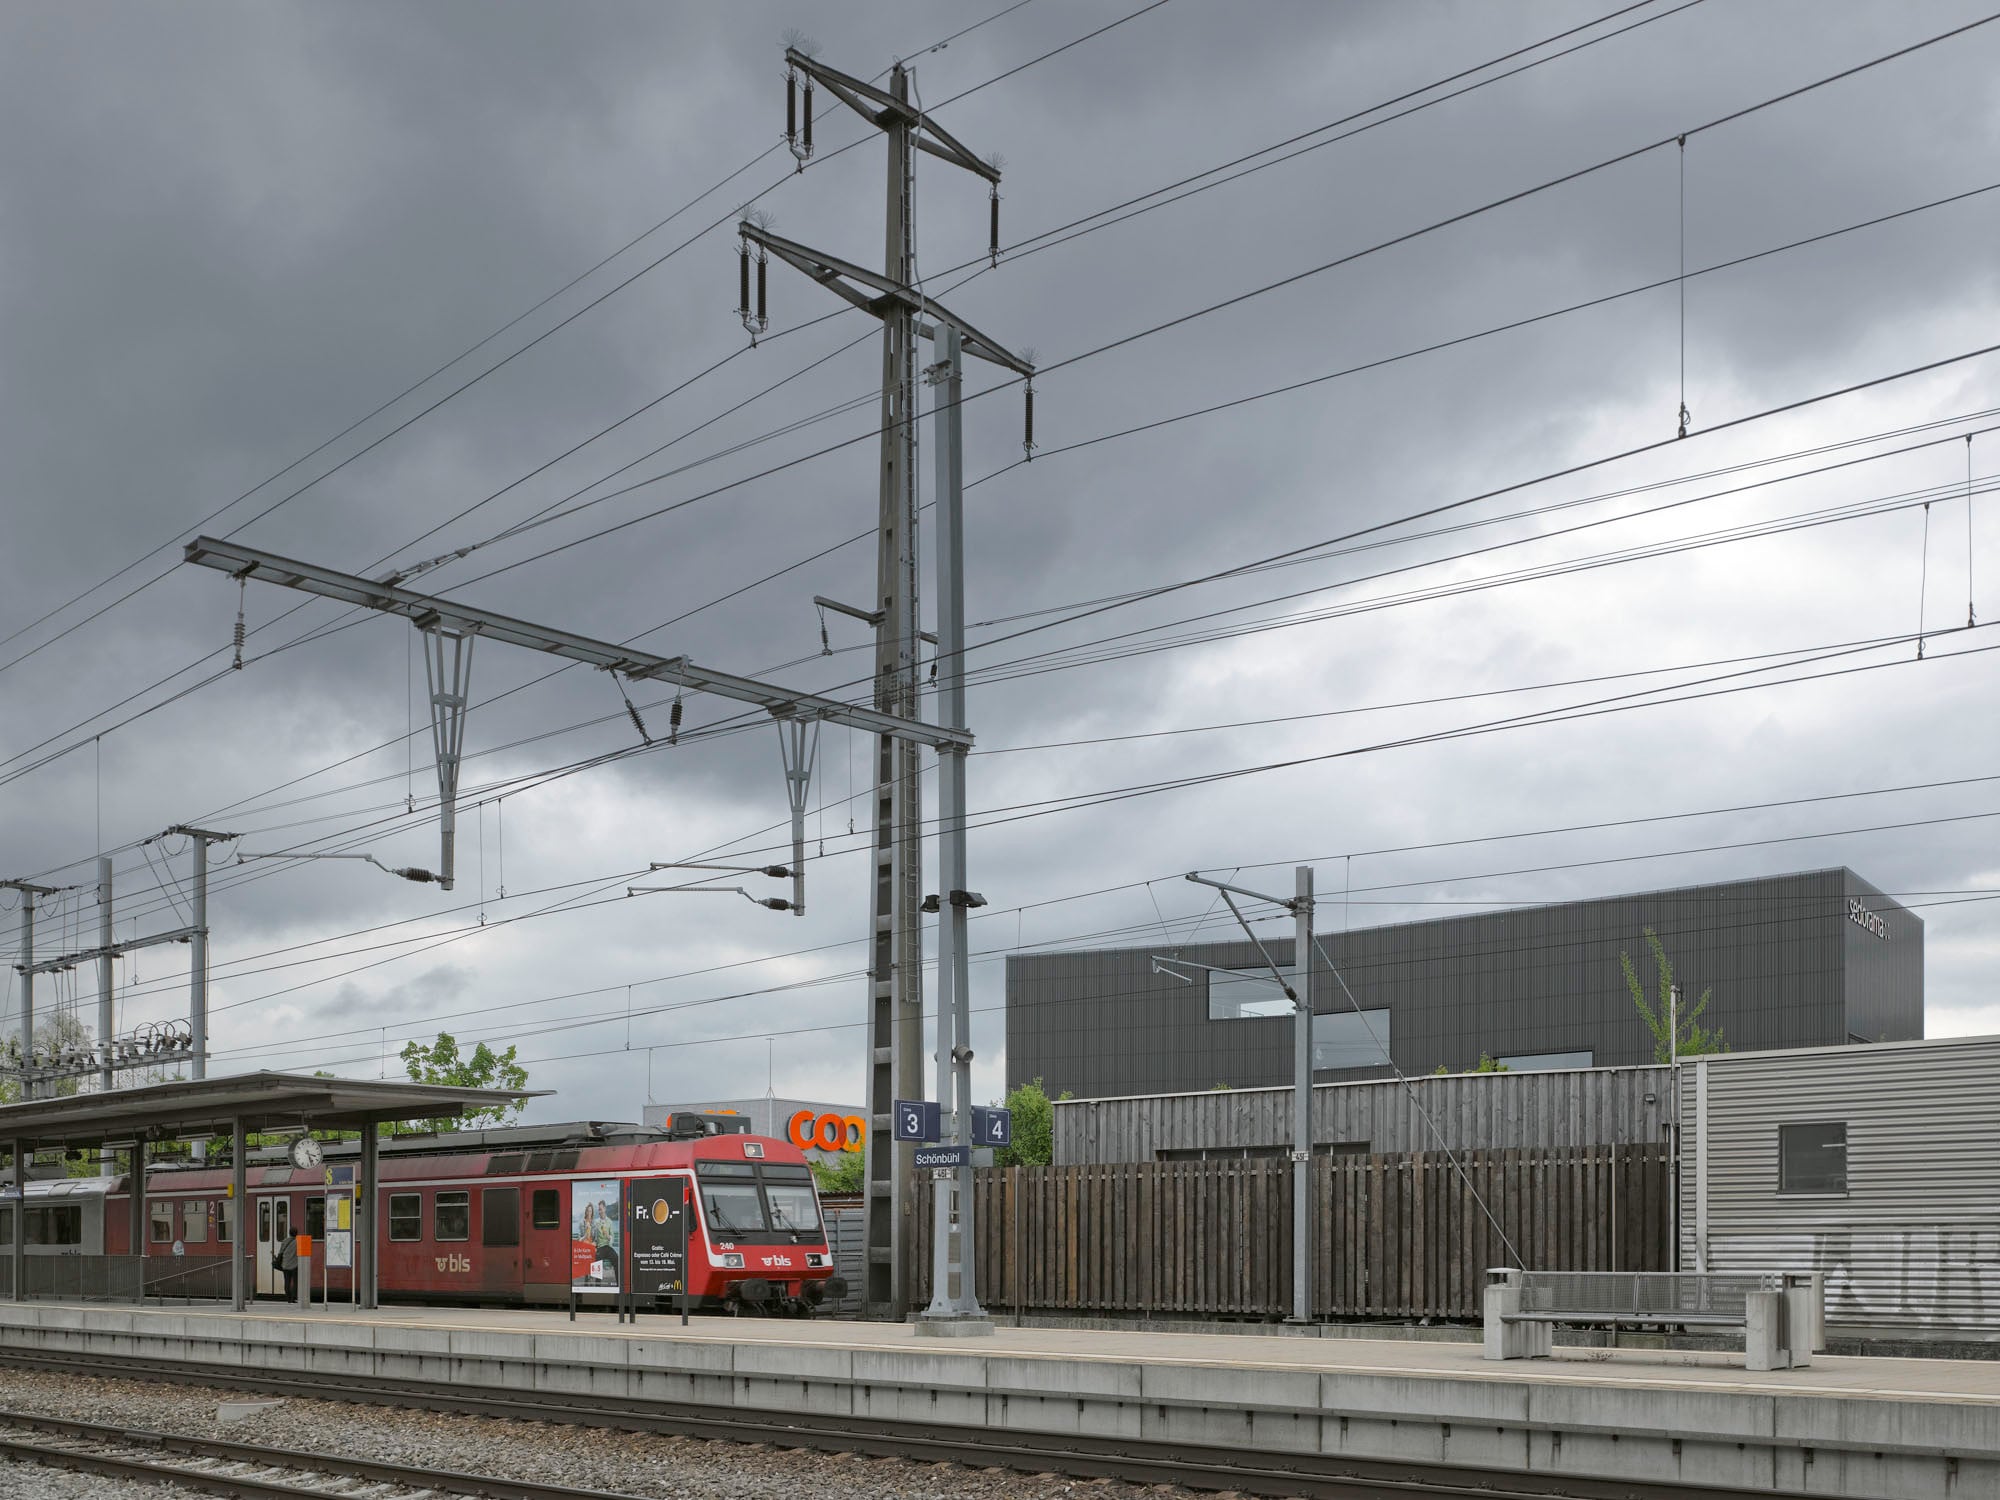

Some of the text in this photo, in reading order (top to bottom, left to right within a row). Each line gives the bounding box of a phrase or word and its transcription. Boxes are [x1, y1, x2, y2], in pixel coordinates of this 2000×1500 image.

[789, 1110, 866, 1153] coo
[907, 1114, 919, 1133] 3
[992, 1120, 1003, 1139] 4
[916, 1153, 960, 1165] Schönbühl
[636, 1206, 649, 1219] Fr.
[720, 1242, 735, 1250] 240
[449, 1253, 470, 1272] bls
[773, 1255, 792, 1266] bls
